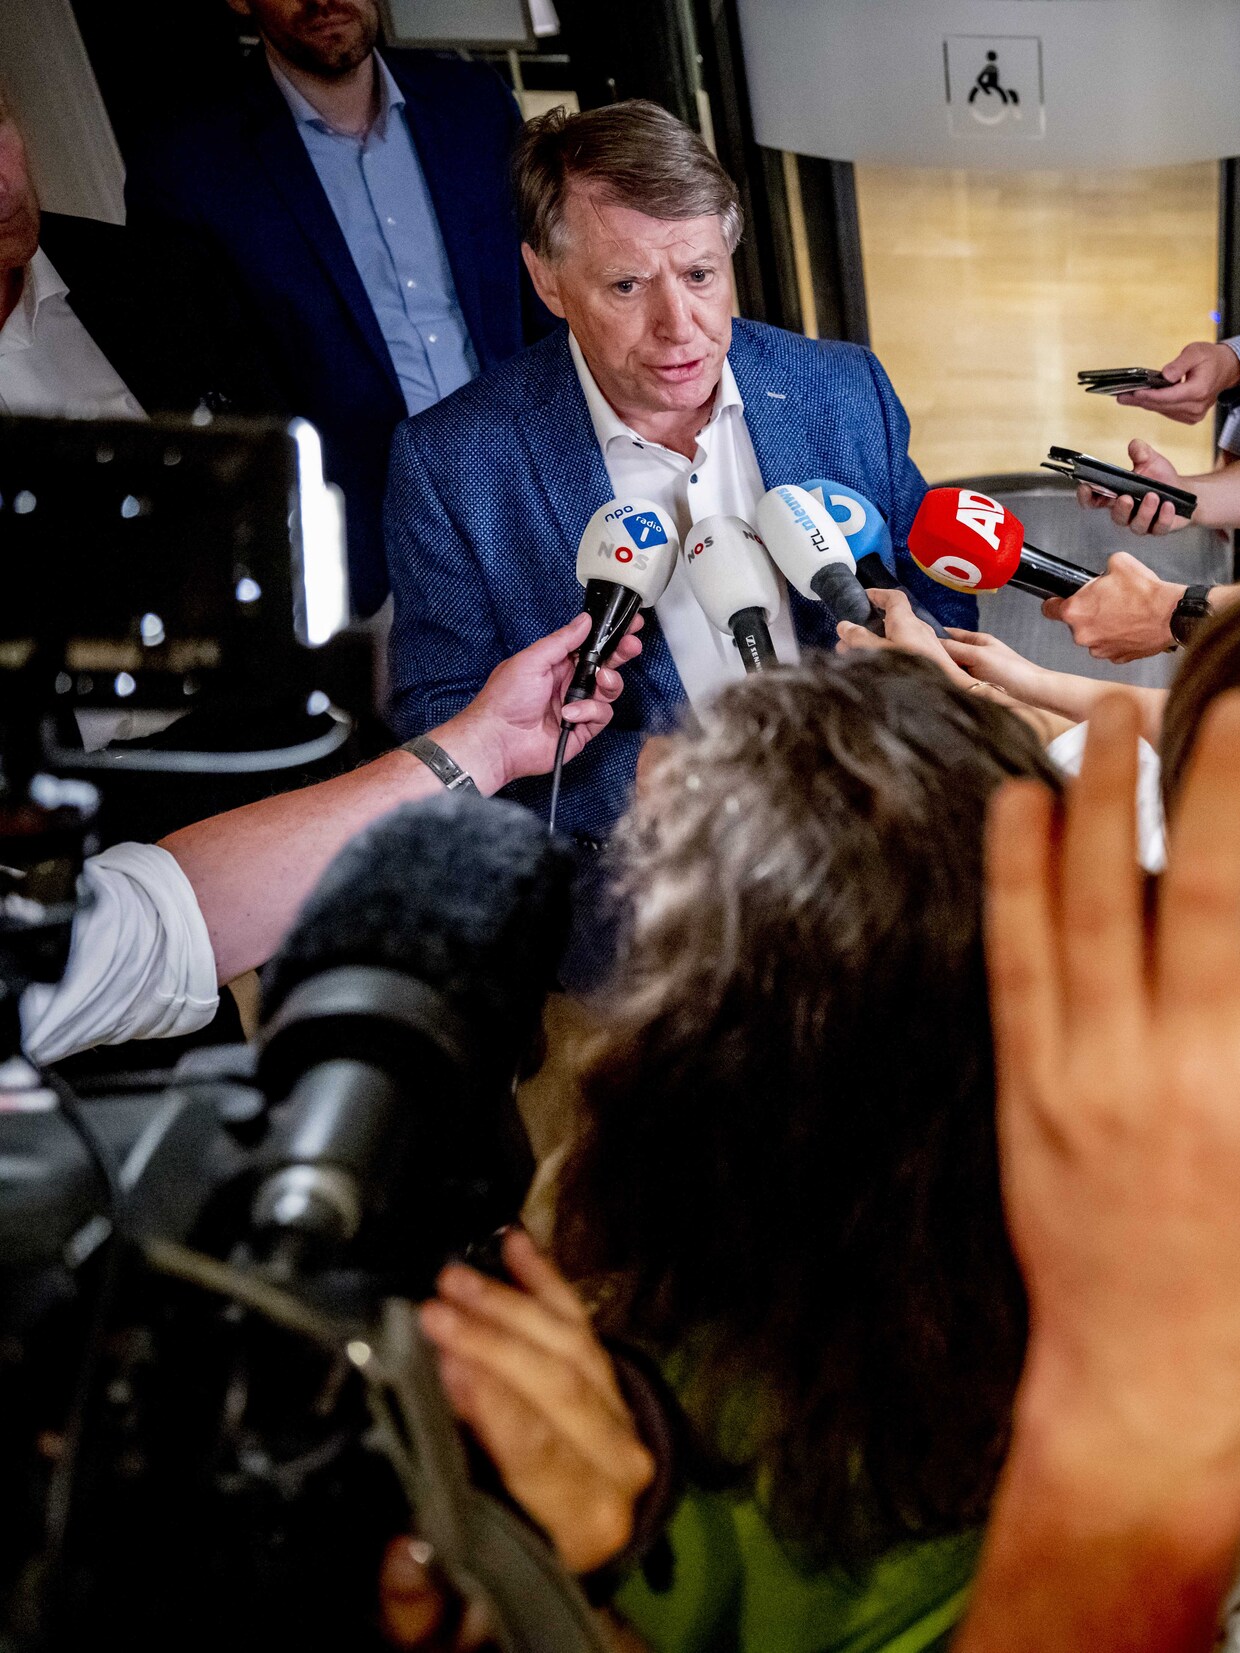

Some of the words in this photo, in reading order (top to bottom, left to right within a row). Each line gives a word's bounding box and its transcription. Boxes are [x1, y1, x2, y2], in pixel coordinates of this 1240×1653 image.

[604, 505, 634, 522] npo
[635, 516, 662, 533] radio
[955, 489, 1005, 551] AD
[597, 541, 650, 571] NOS
[687, 536, 714, 565] NOS
